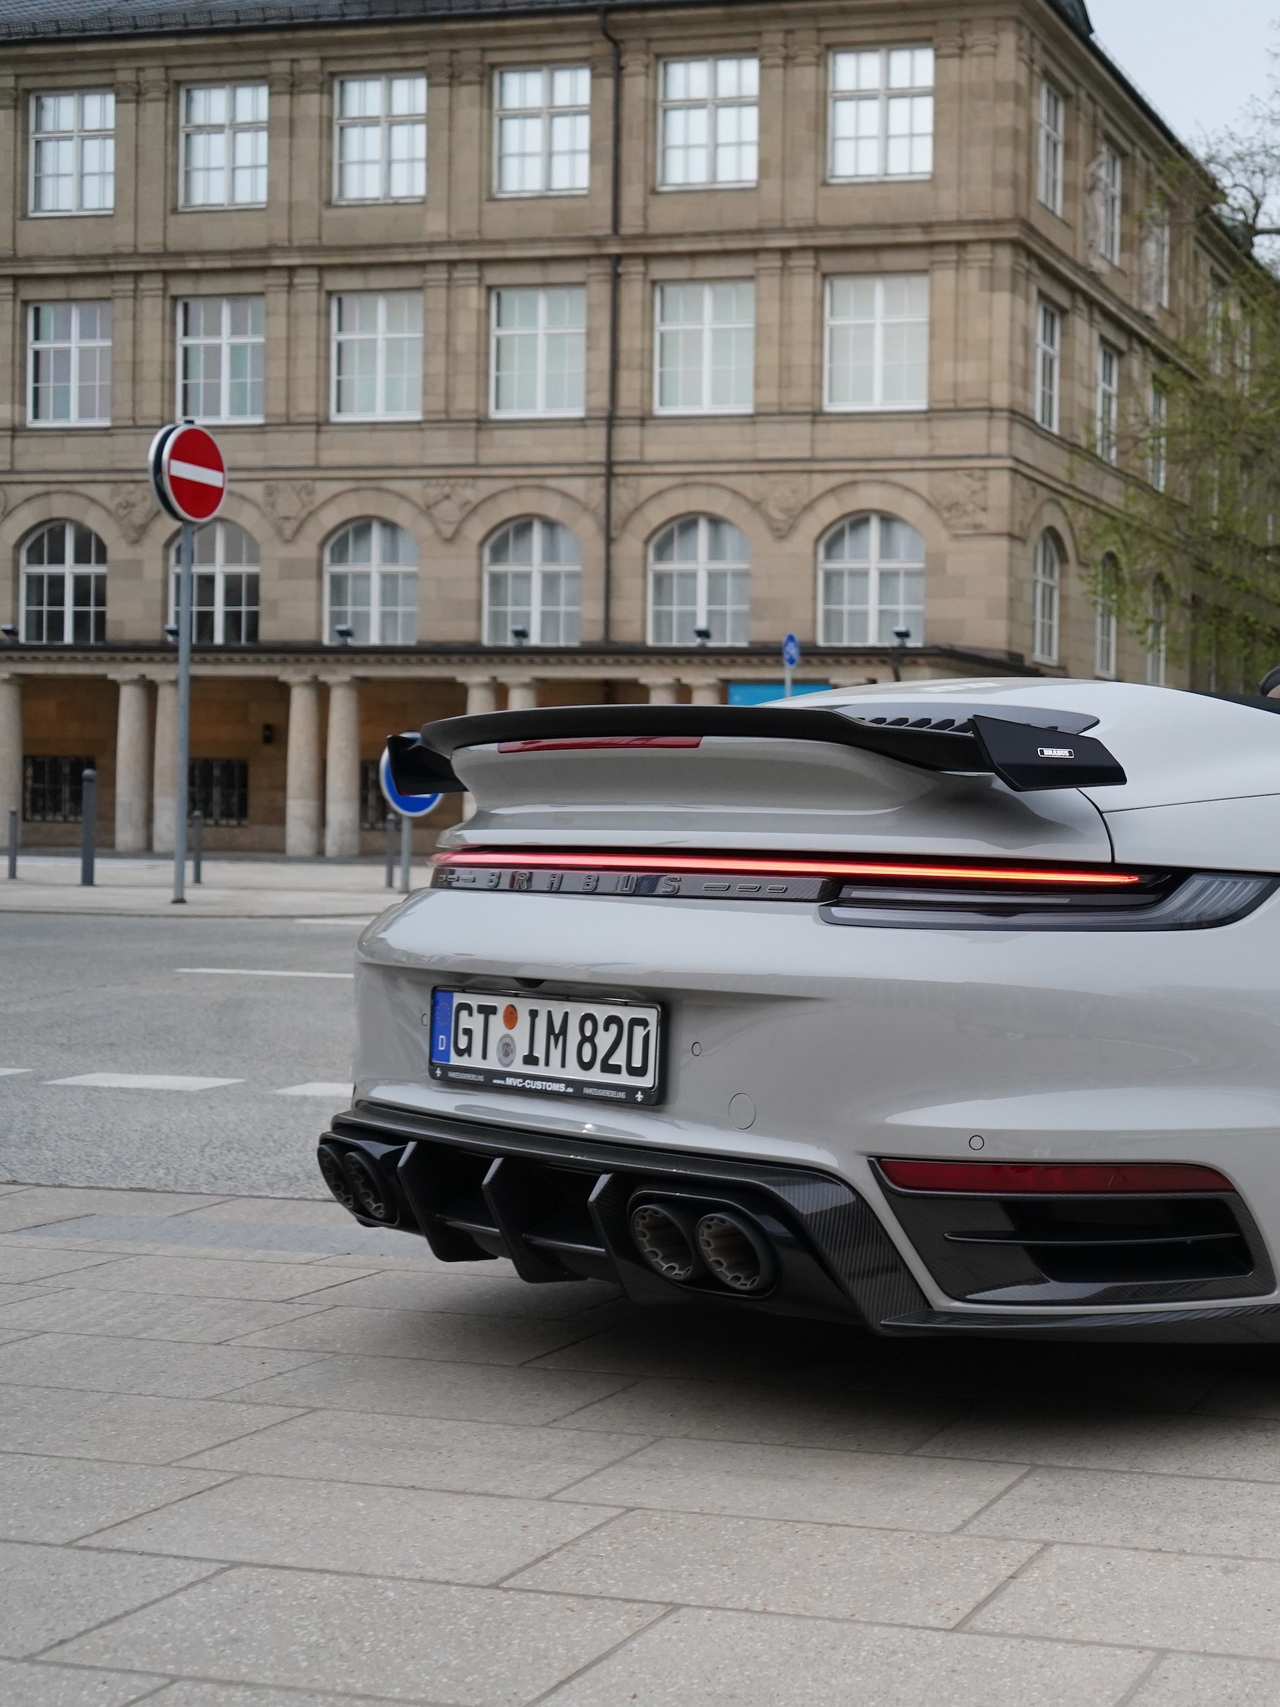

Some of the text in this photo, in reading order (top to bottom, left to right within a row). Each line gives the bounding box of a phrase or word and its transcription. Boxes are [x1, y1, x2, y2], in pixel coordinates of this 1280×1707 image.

[486, 869, 683, 895] BRABUS
[438, 1035, 446, 1050] D
[453, 1001, 650, 1077] GT IM 820
[492, 1077, 574, 1093] www.MVC-CUSTOMS.de
